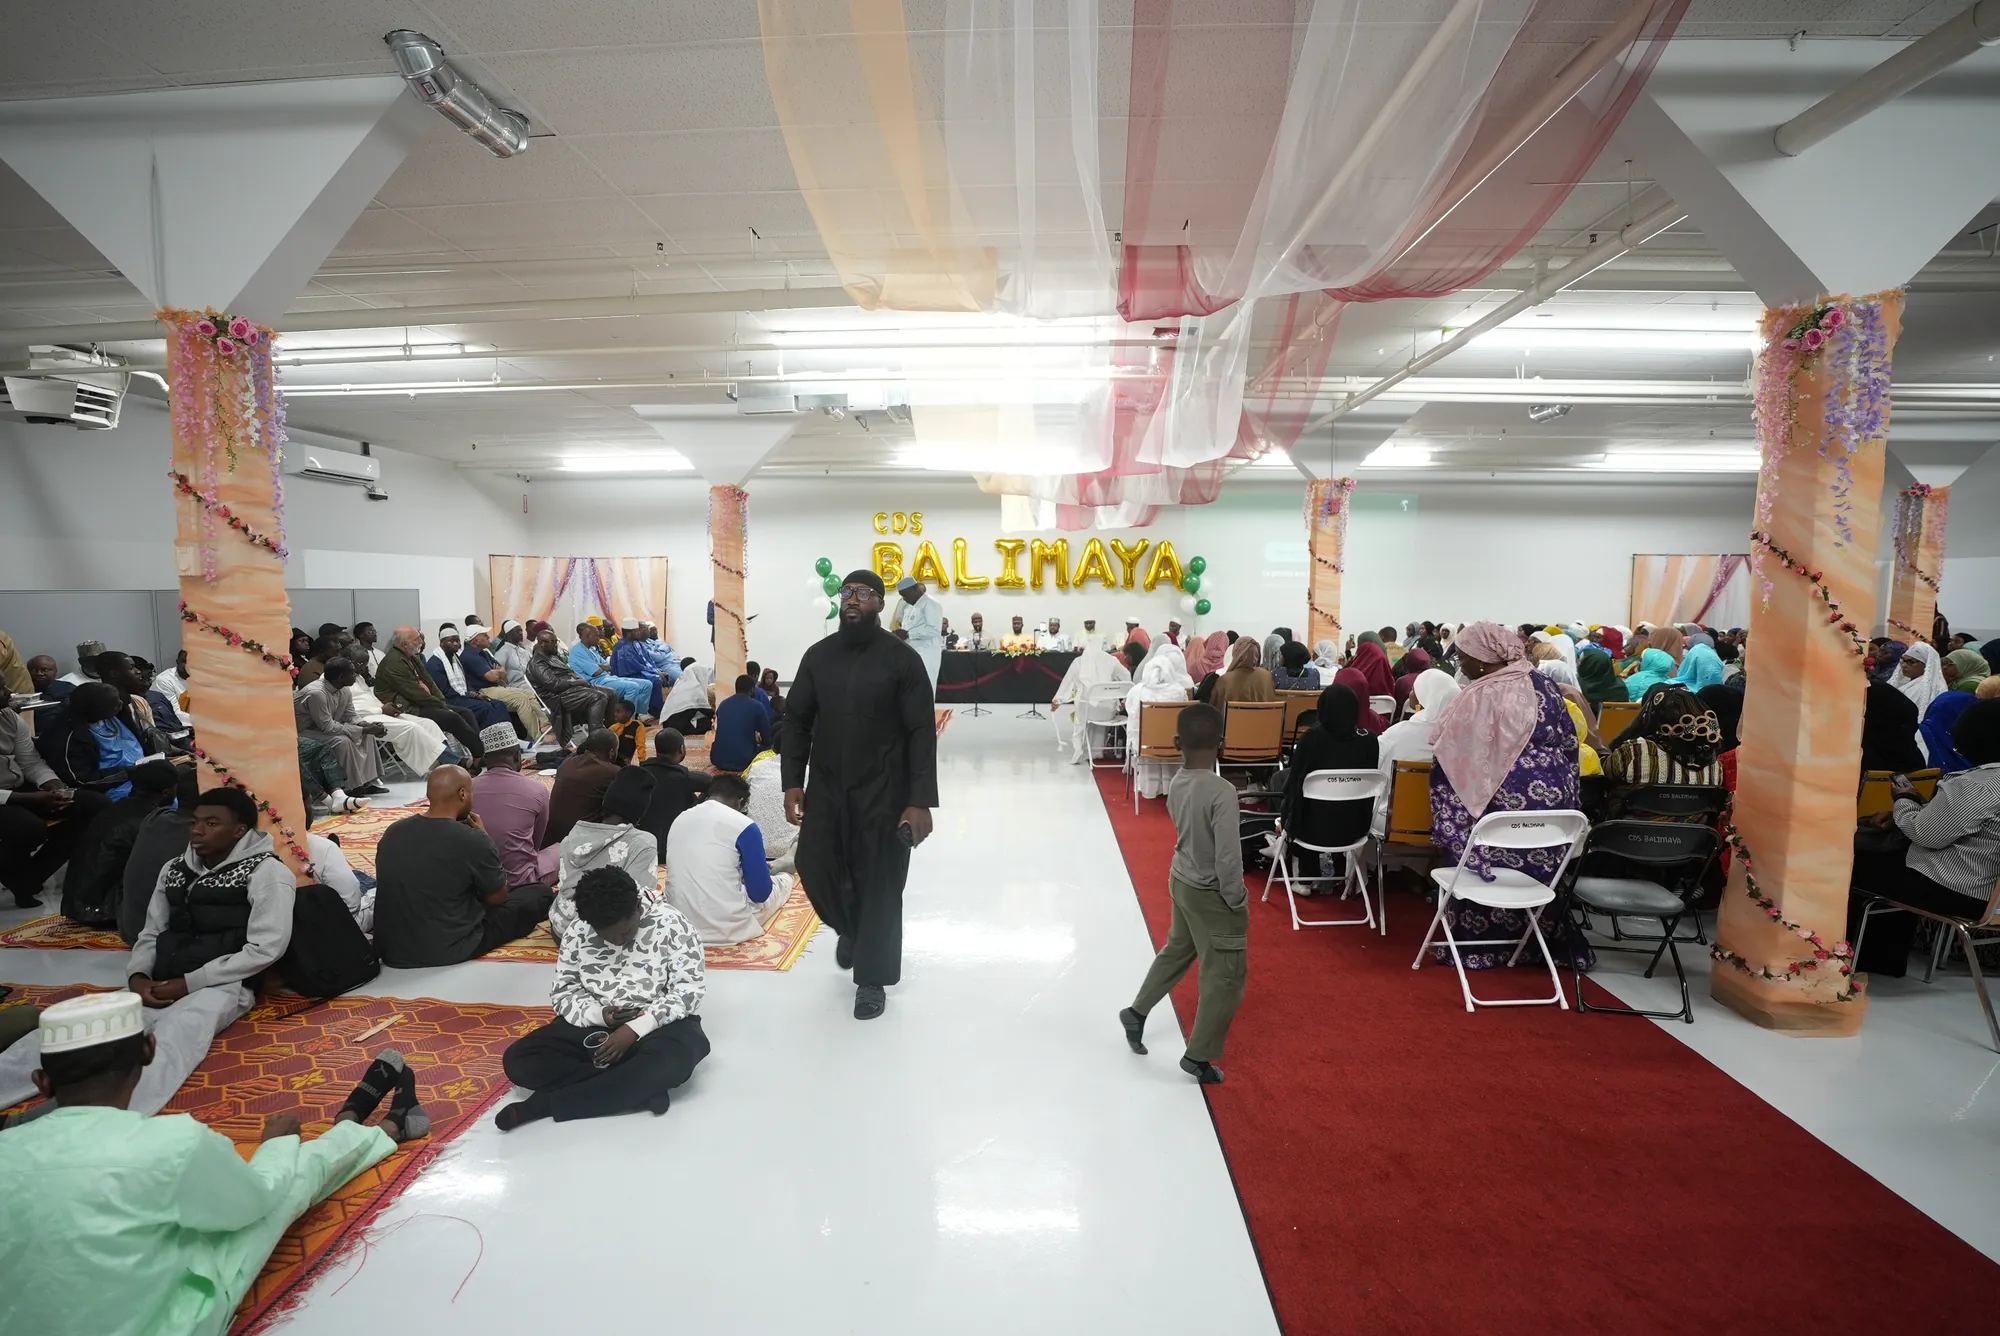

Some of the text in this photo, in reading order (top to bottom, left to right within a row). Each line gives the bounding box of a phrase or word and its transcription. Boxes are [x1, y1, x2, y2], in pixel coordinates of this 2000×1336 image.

[873, 512, 923, 535] CDS
[872, 537, 1185, 591] BALIMAYA
[1628, 834, 1682, 845] CDS BALIMAYA
